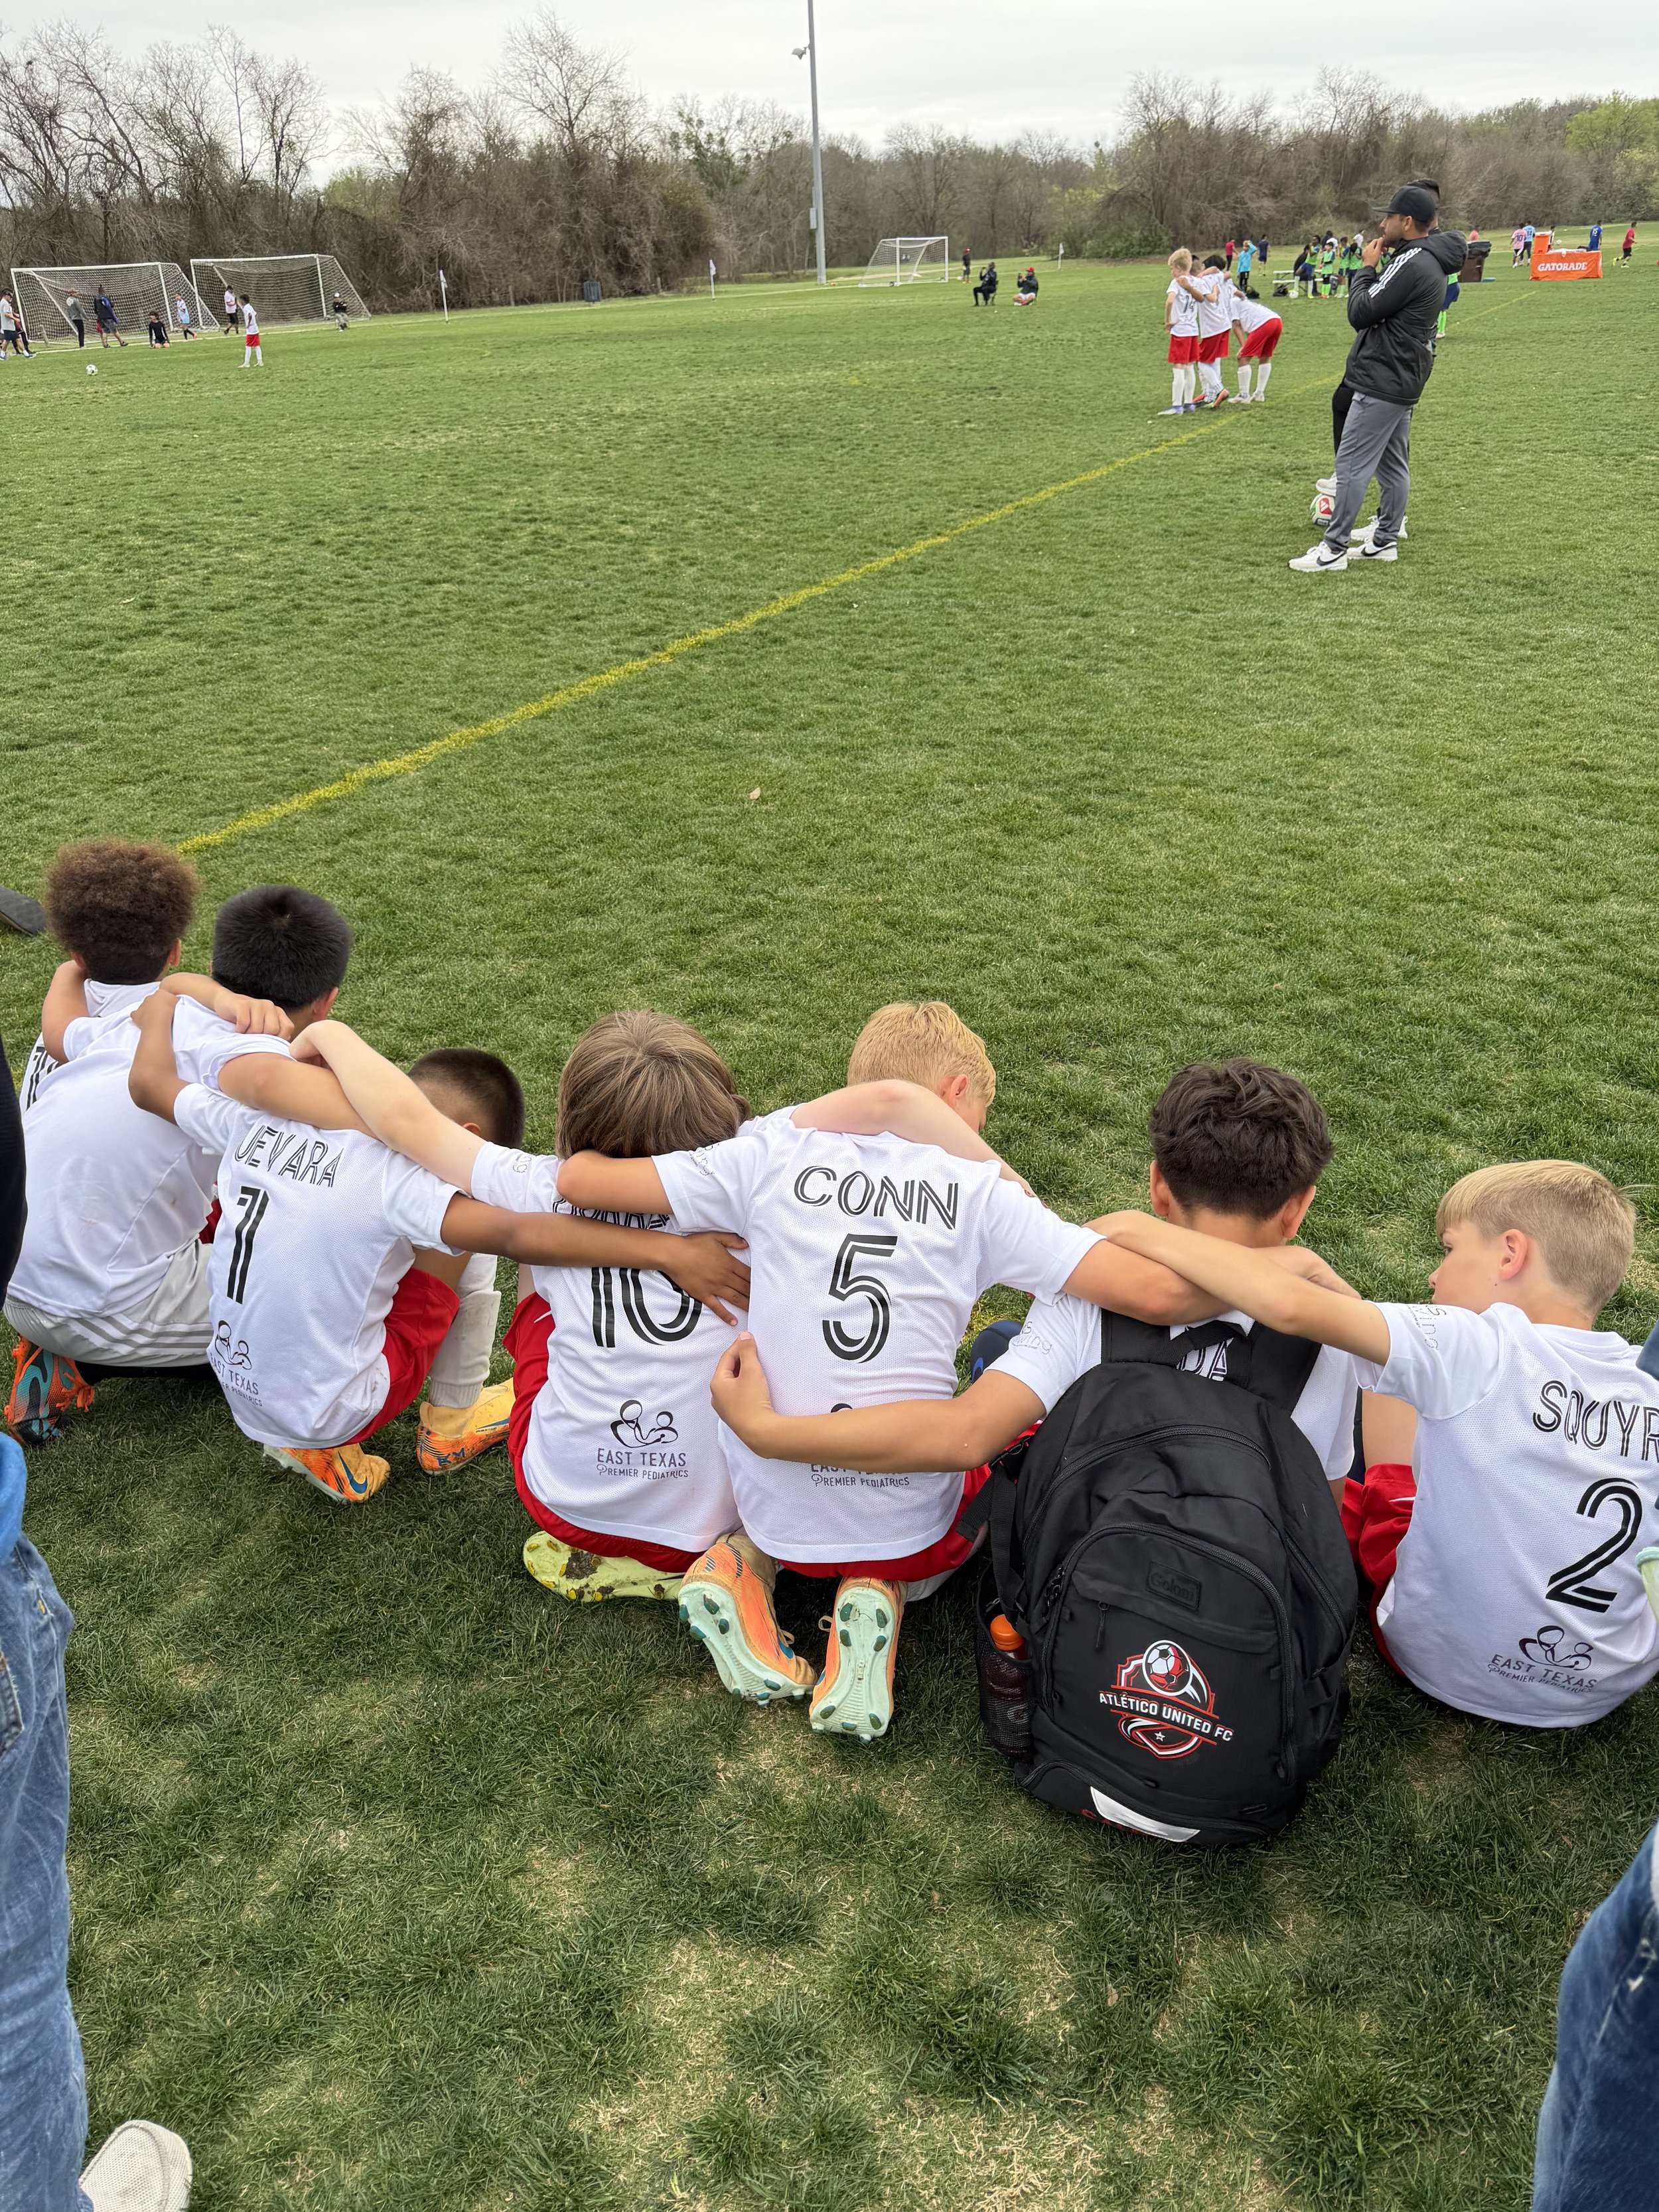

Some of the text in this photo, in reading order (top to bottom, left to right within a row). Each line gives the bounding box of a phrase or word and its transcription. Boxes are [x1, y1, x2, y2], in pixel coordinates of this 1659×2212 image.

[1538, 262, 1587, 271] GATORADE
[794, 1165, 959, 1230] CONN
[591, 1266, 703, 1348] 10
[822, 1233, 898, 1363] 5
[229, 1370, 259, 1395] TEXAS
[597, 1447, 686, 1468] EAST TEXAS
[597, 1464, 688, 1479] PREMIER PEDIATRICS
[811, 1473, 910, 1488] PREMIER PEDIATRICS
[1545, 1477, 1642, 1613] 2
[1488, 1664, 1535, 1682] PREMIER
[1491, 1654, 1597, 1688] EAST TEXAS
[1099, 1692, 1234, 1741] ATLÉTICO UNITED FC
